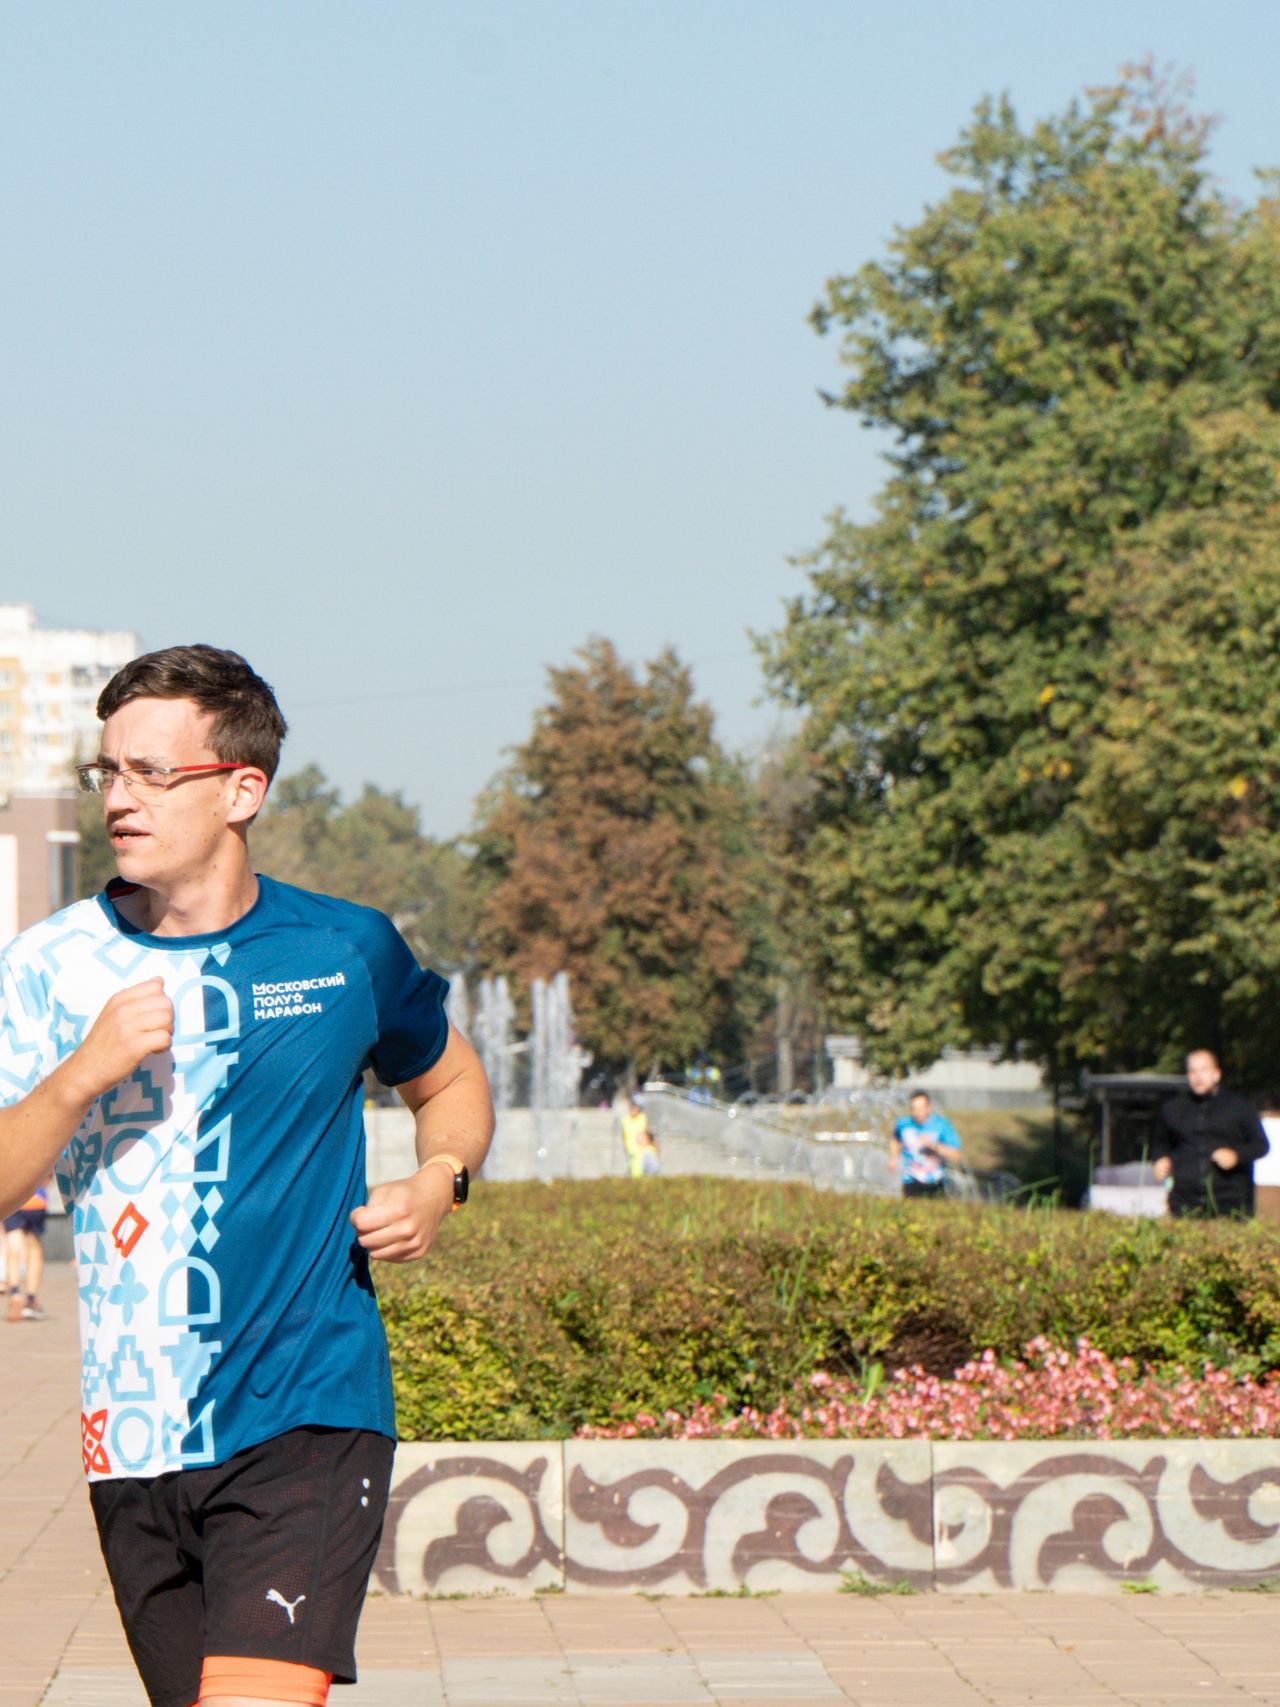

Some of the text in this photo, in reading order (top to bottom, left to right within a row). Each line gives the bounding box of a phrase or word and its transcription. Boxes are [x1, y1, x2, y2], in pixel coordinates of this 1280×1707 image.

[252, 972, 345, 995] МОСКОВСКИЙ
[254, 993, 291, 1008] ПОЛУ
[254, 1003, 322, 1020] МАРАФОН
